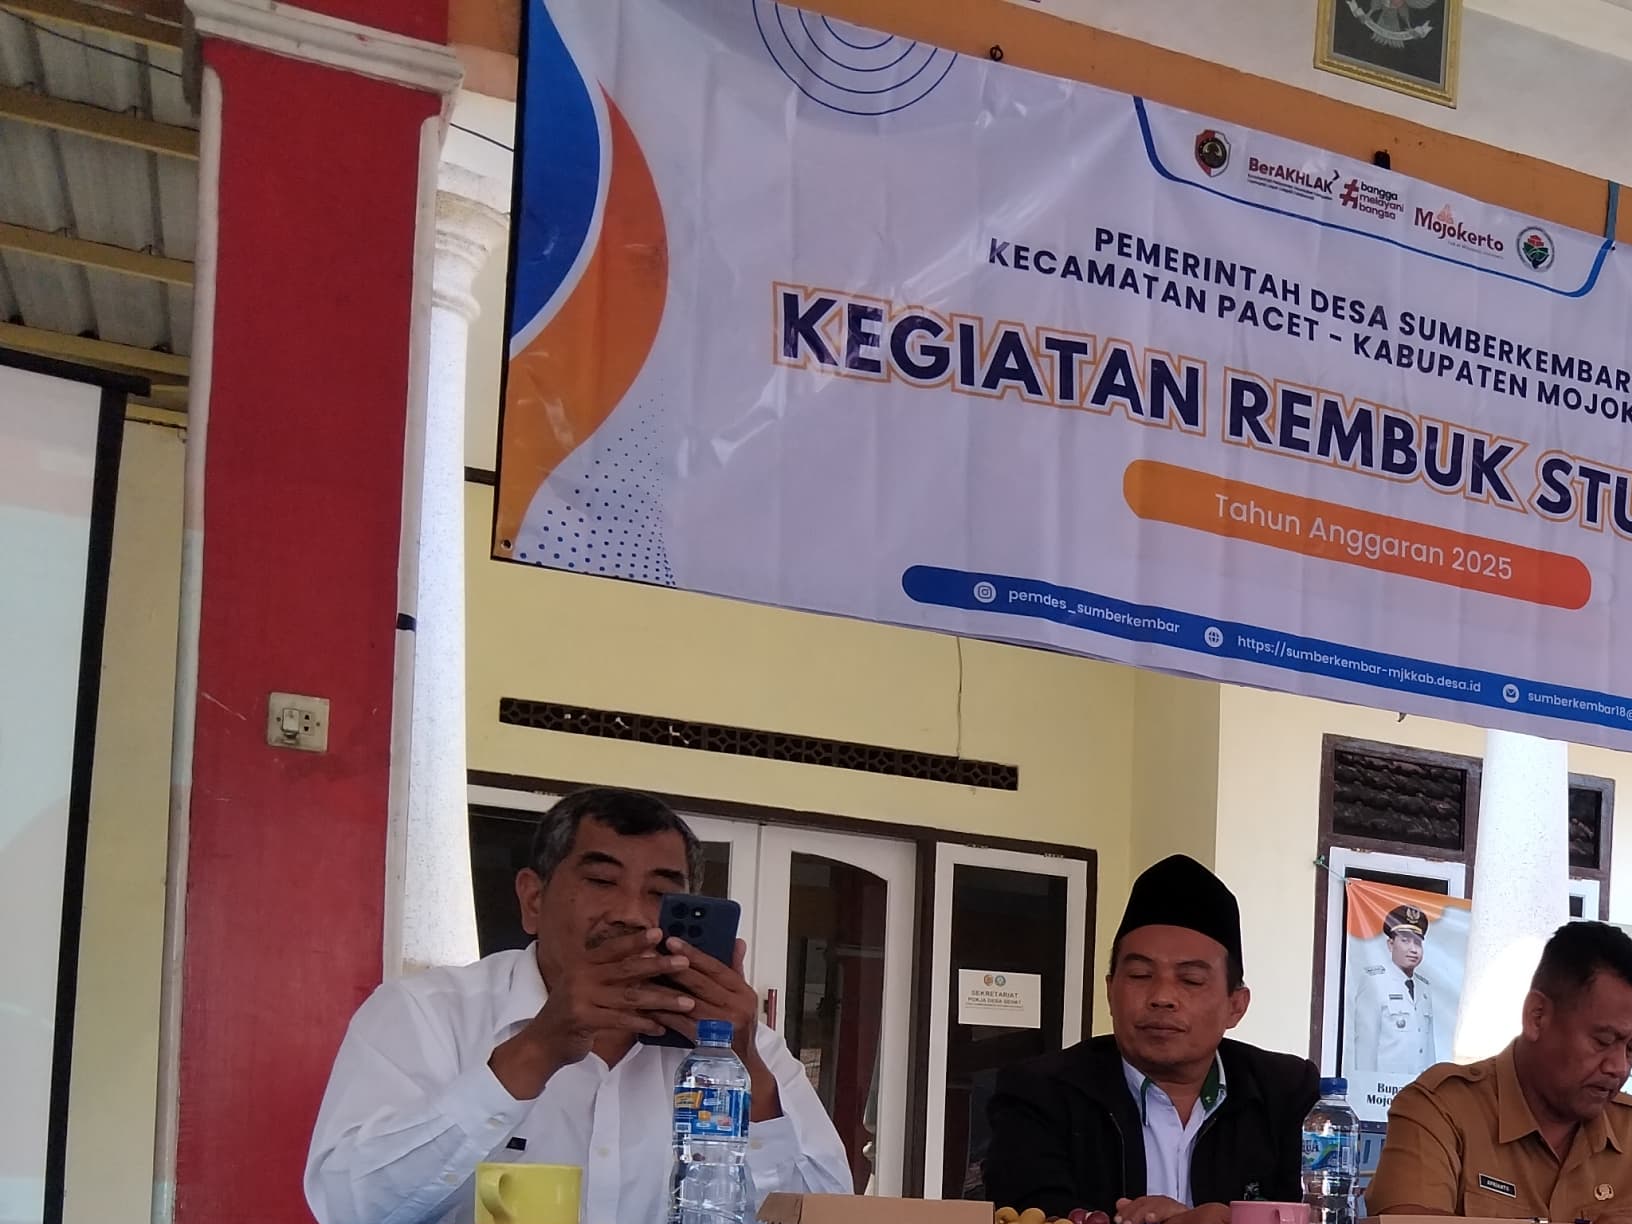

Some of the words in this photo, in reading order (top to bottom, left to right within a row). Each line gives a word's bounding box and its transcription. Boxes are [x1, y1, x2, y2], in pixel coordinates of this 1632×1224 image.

[1248, 157, 1333, 194] BerAKHLAK
[1360, 181, 1398, 201] bangga
[1359, 194, 1404, 213] melayani
[1359, 203, 1396, 220] bangsa
[1414, 206, 1504, 252] Mojokerto
[988, 237, 1206, 313] KECAMATAN
[1218, 293, 1319, 341] PACET
[1353, 331, 1527, 399] KABUPATEN
[1095, 227, 1300, 305] PEMERINTAH
[1311, 288, 1389, 331] DESA
[1399, 310, 1631, 394] SUMBERKEMBAR
[780, 289, 1202, 430] KEGIATAN
[1227, 376, 1515, 503] REMBUK
[1215, 492, 1301, 535] Tahun
[1308, 516, 1445, 567] Anggaran
[1451, 545, 1513, 582] 2025
[1008, 587, 1181, 634] pemdes_sumberkembar
[1237, 634, 1481, 694] https://sumberkembar-mjkkab.desa.id
[1366, 1094, 1393, 1107] Mojo
[1377, 1082, 1403, 1096] Bup
